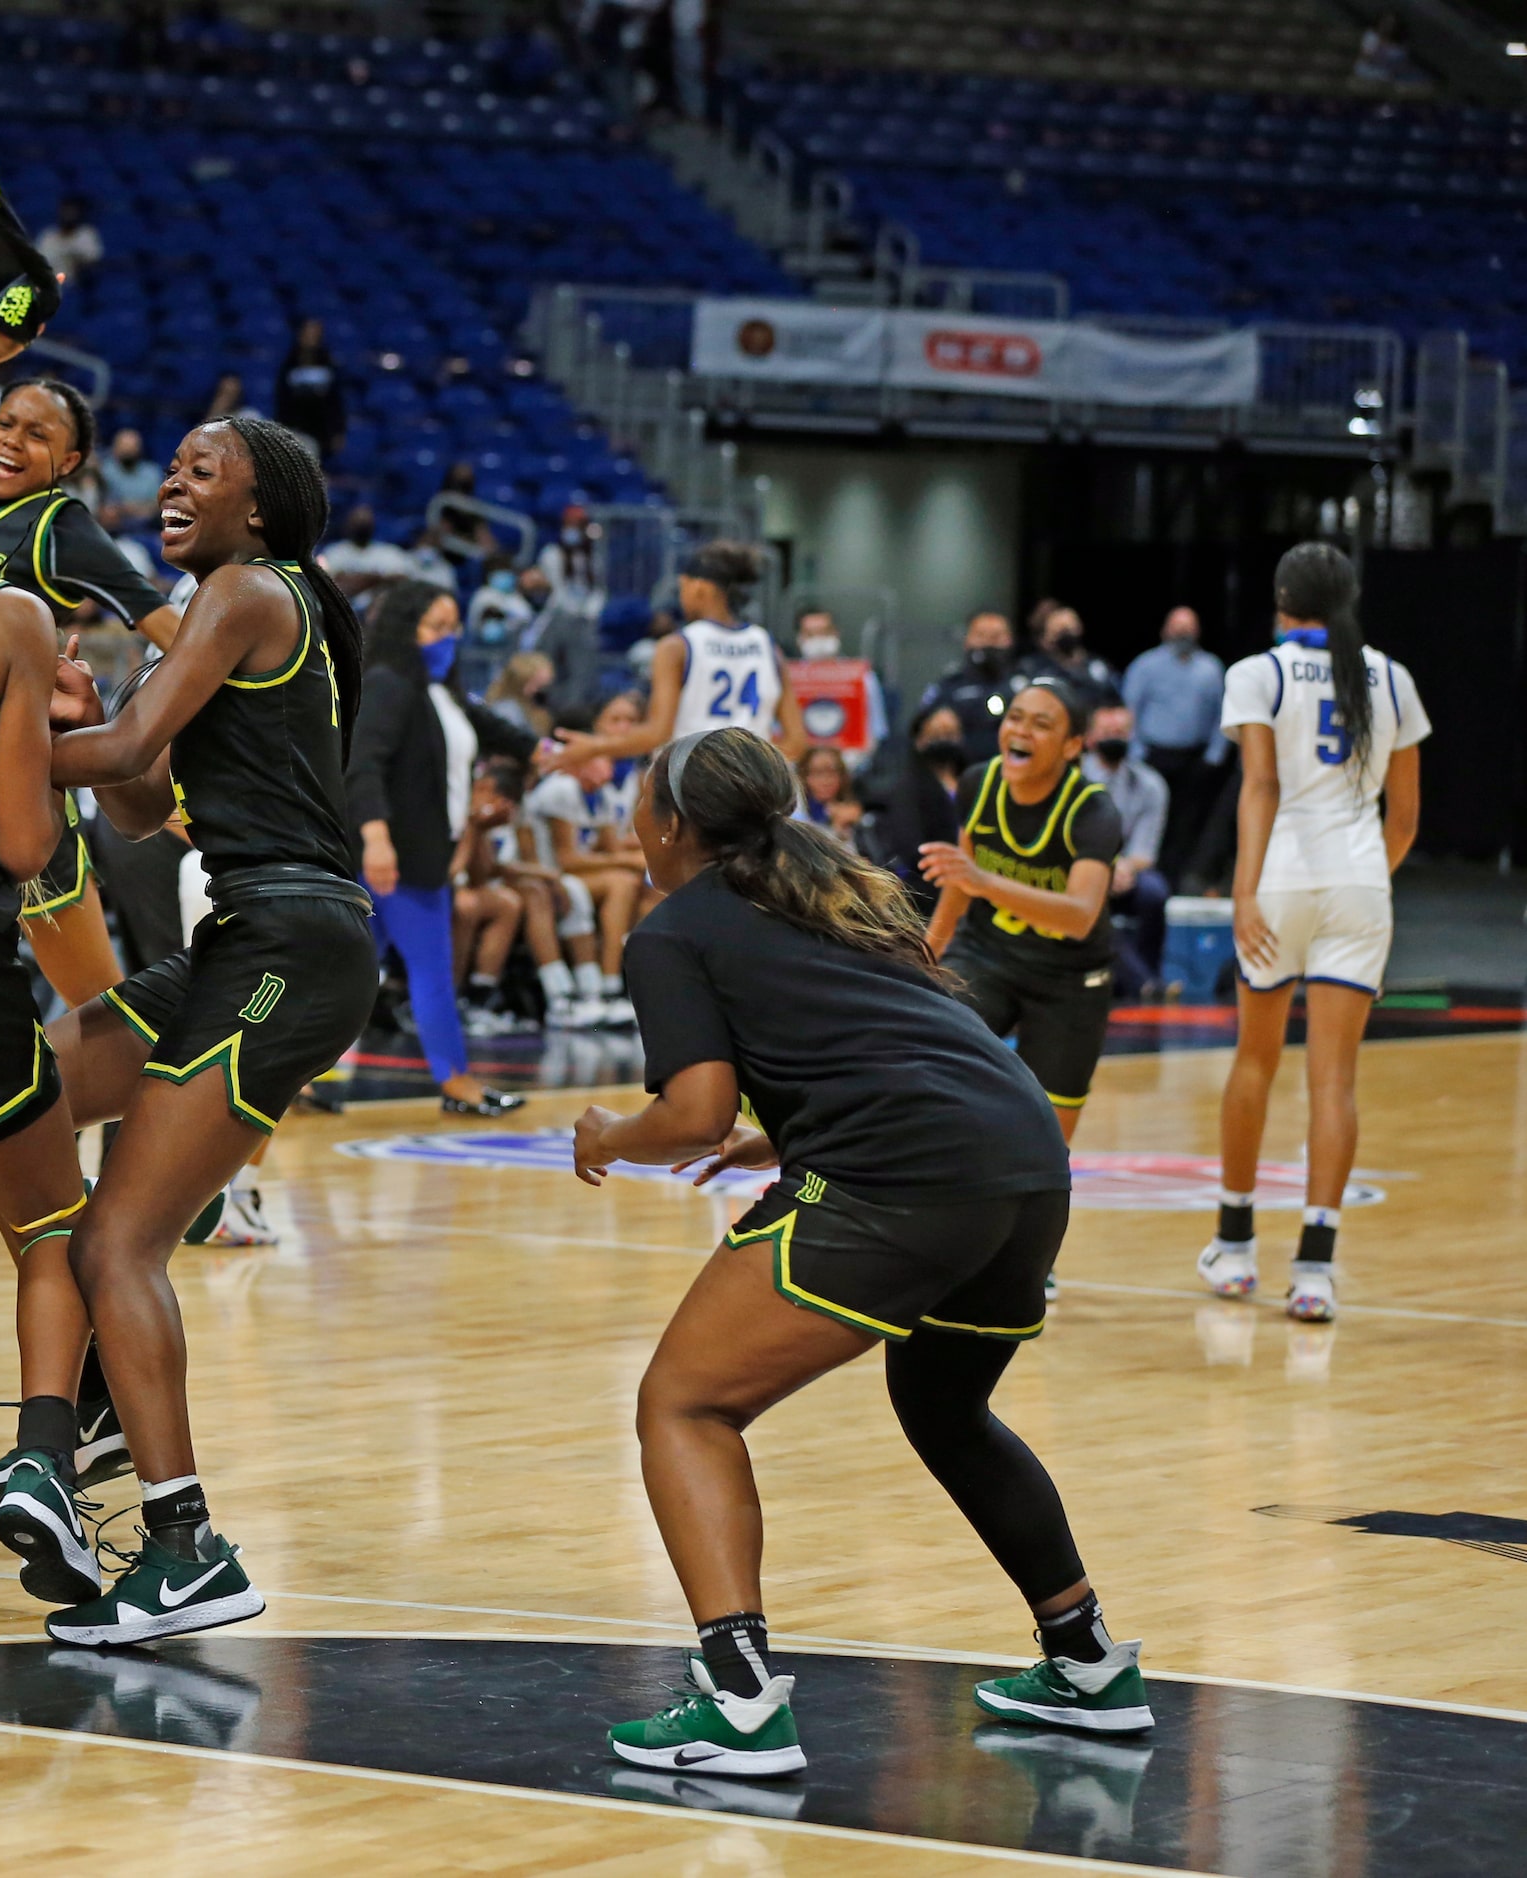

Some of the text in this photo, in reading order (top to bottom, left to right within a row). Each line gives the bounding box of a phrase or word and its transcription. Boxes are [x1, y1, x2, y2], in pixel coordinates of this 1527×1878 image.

[709, 670, 760, 717] 24
[1291, 662, 1378, 687] COUS
[1315, 699, 1356, 766] 5
[238, 972, 286, 1024] D
